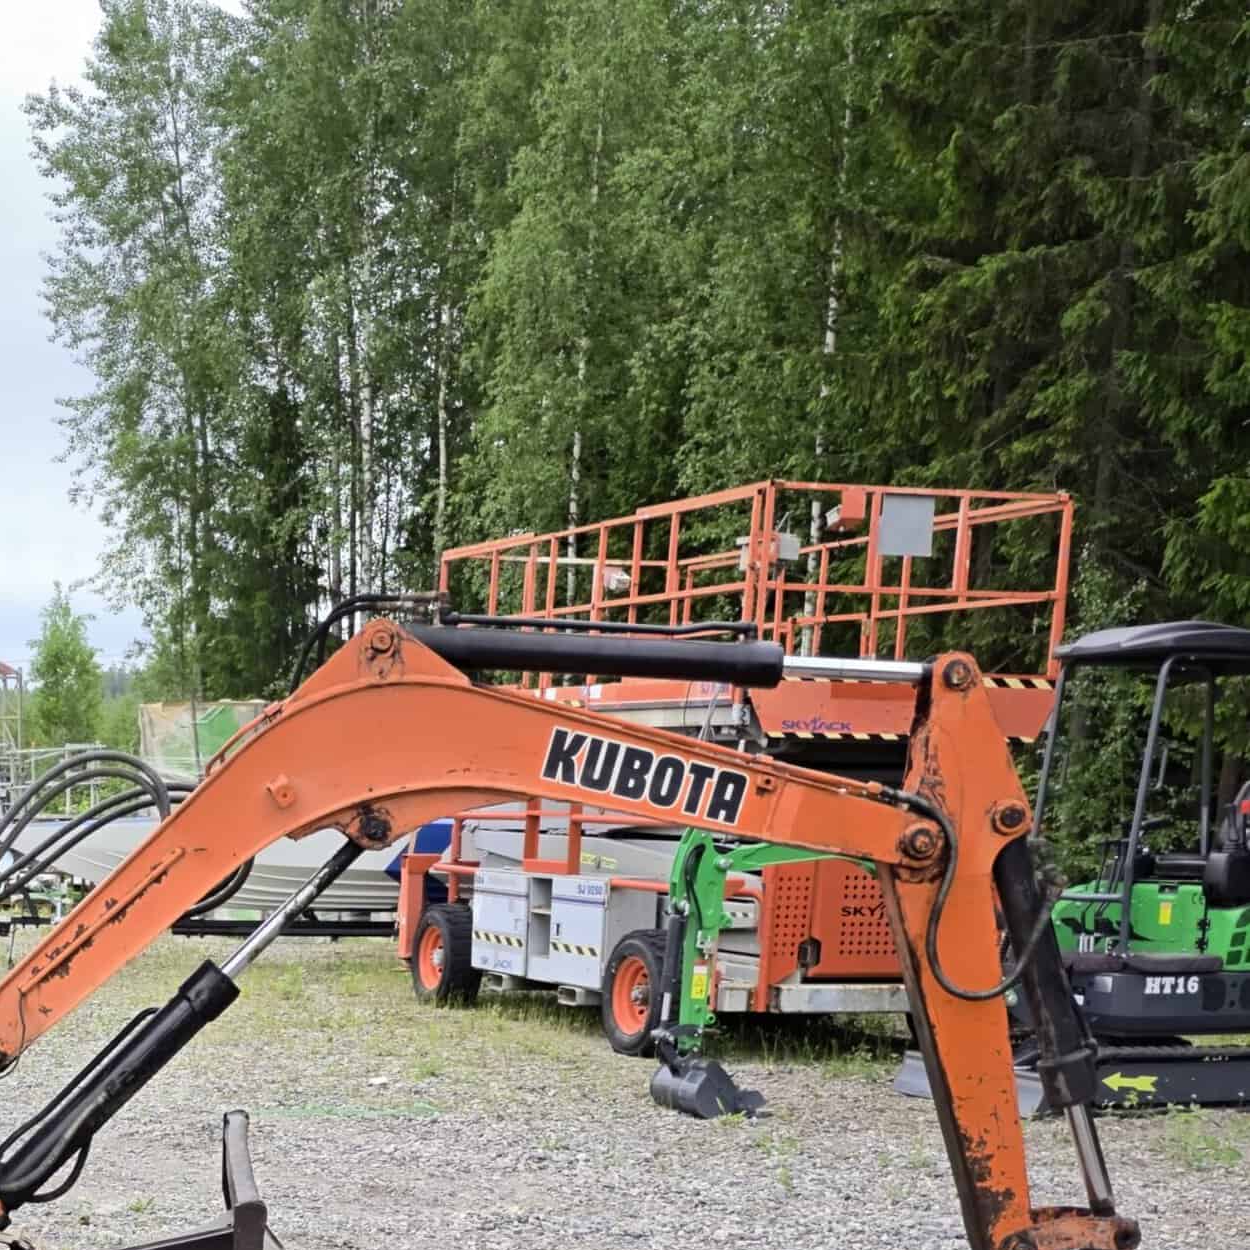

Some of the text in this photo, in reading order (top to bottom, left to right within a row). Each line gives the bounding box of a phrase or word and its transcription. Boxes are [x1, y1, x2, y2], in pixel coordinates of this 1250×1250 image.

[782, 714, 852, 731] SKYJACK
[543, 726, 749, 825] KUBOTA
[841, 901, 886, 920] SKYJ
[1144, 975, 1200, 994] HT16
